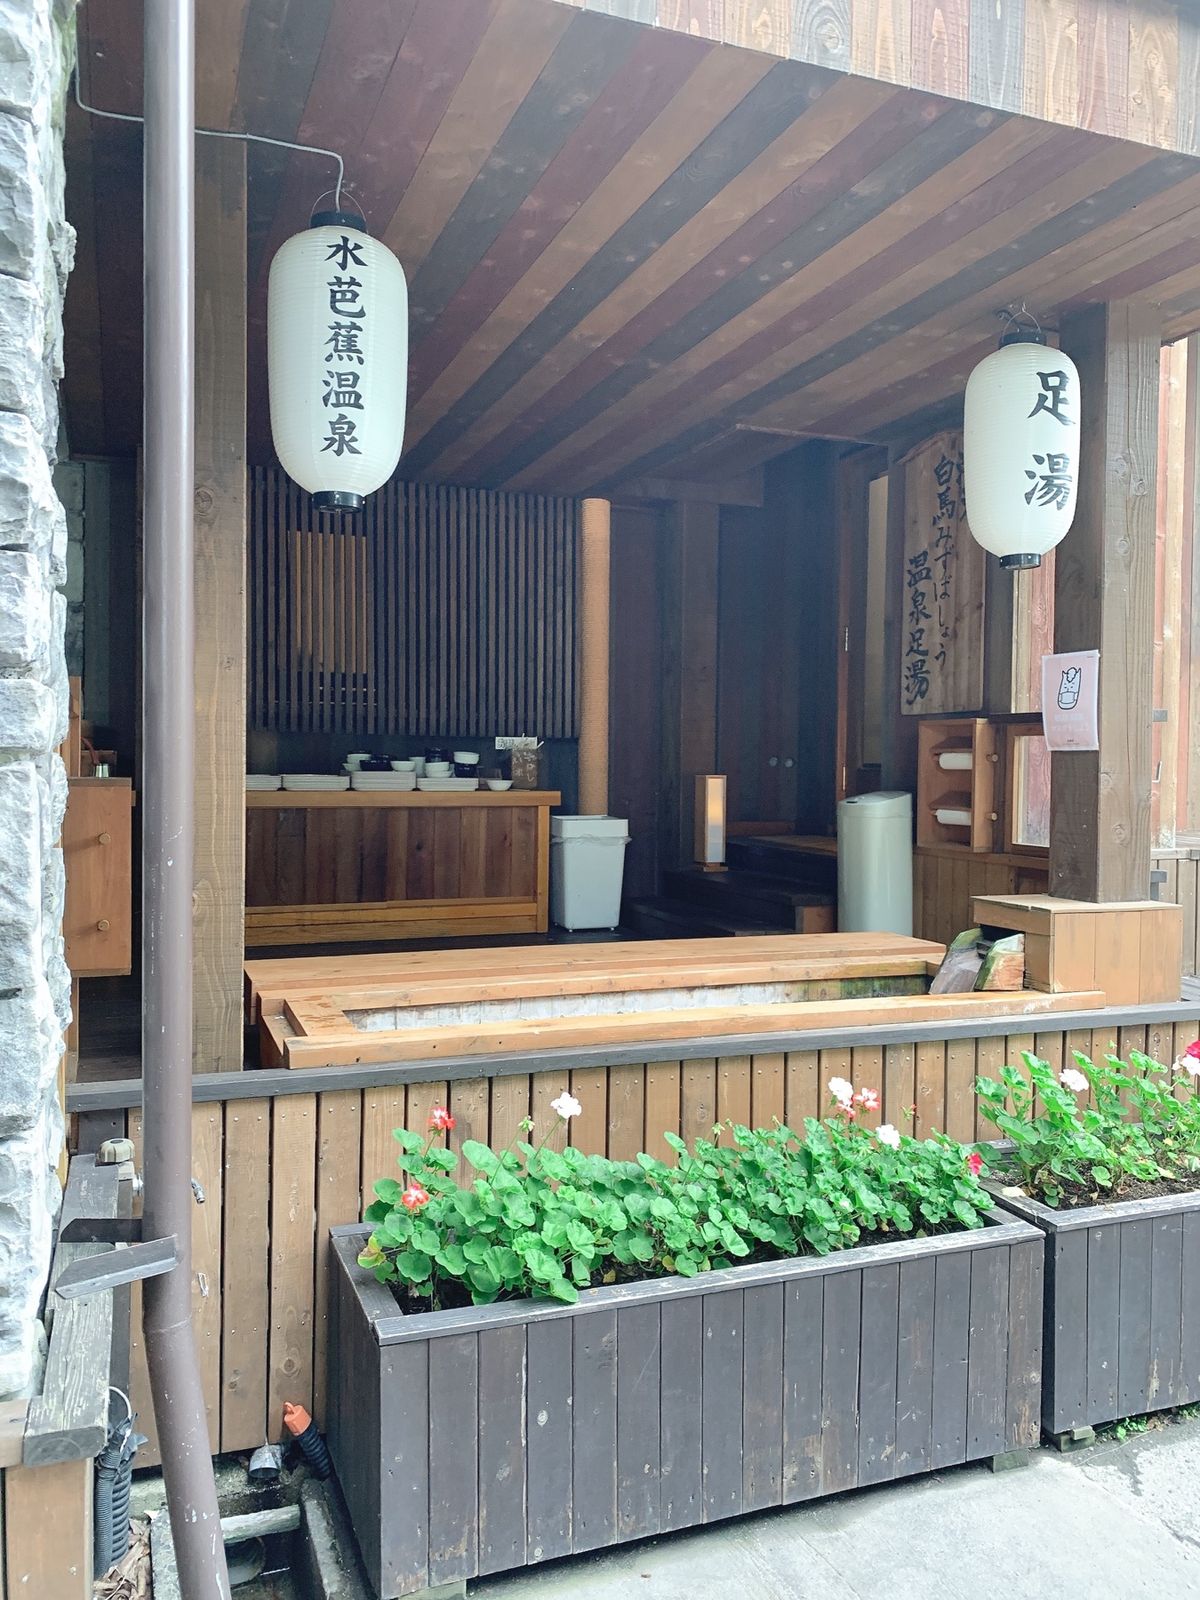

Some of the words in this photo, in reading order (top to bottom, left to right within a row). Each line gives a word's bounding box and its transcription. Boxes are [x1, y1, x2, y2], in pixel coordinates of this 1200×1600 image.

[320, 235, 368, 457] 水芭蕉温泉
[1024, 370, 1076, 511] 足湯
[904, 551, 933, 706] 温泉足湯
[932, 455, 956, 667] 白馬みずばしょう
